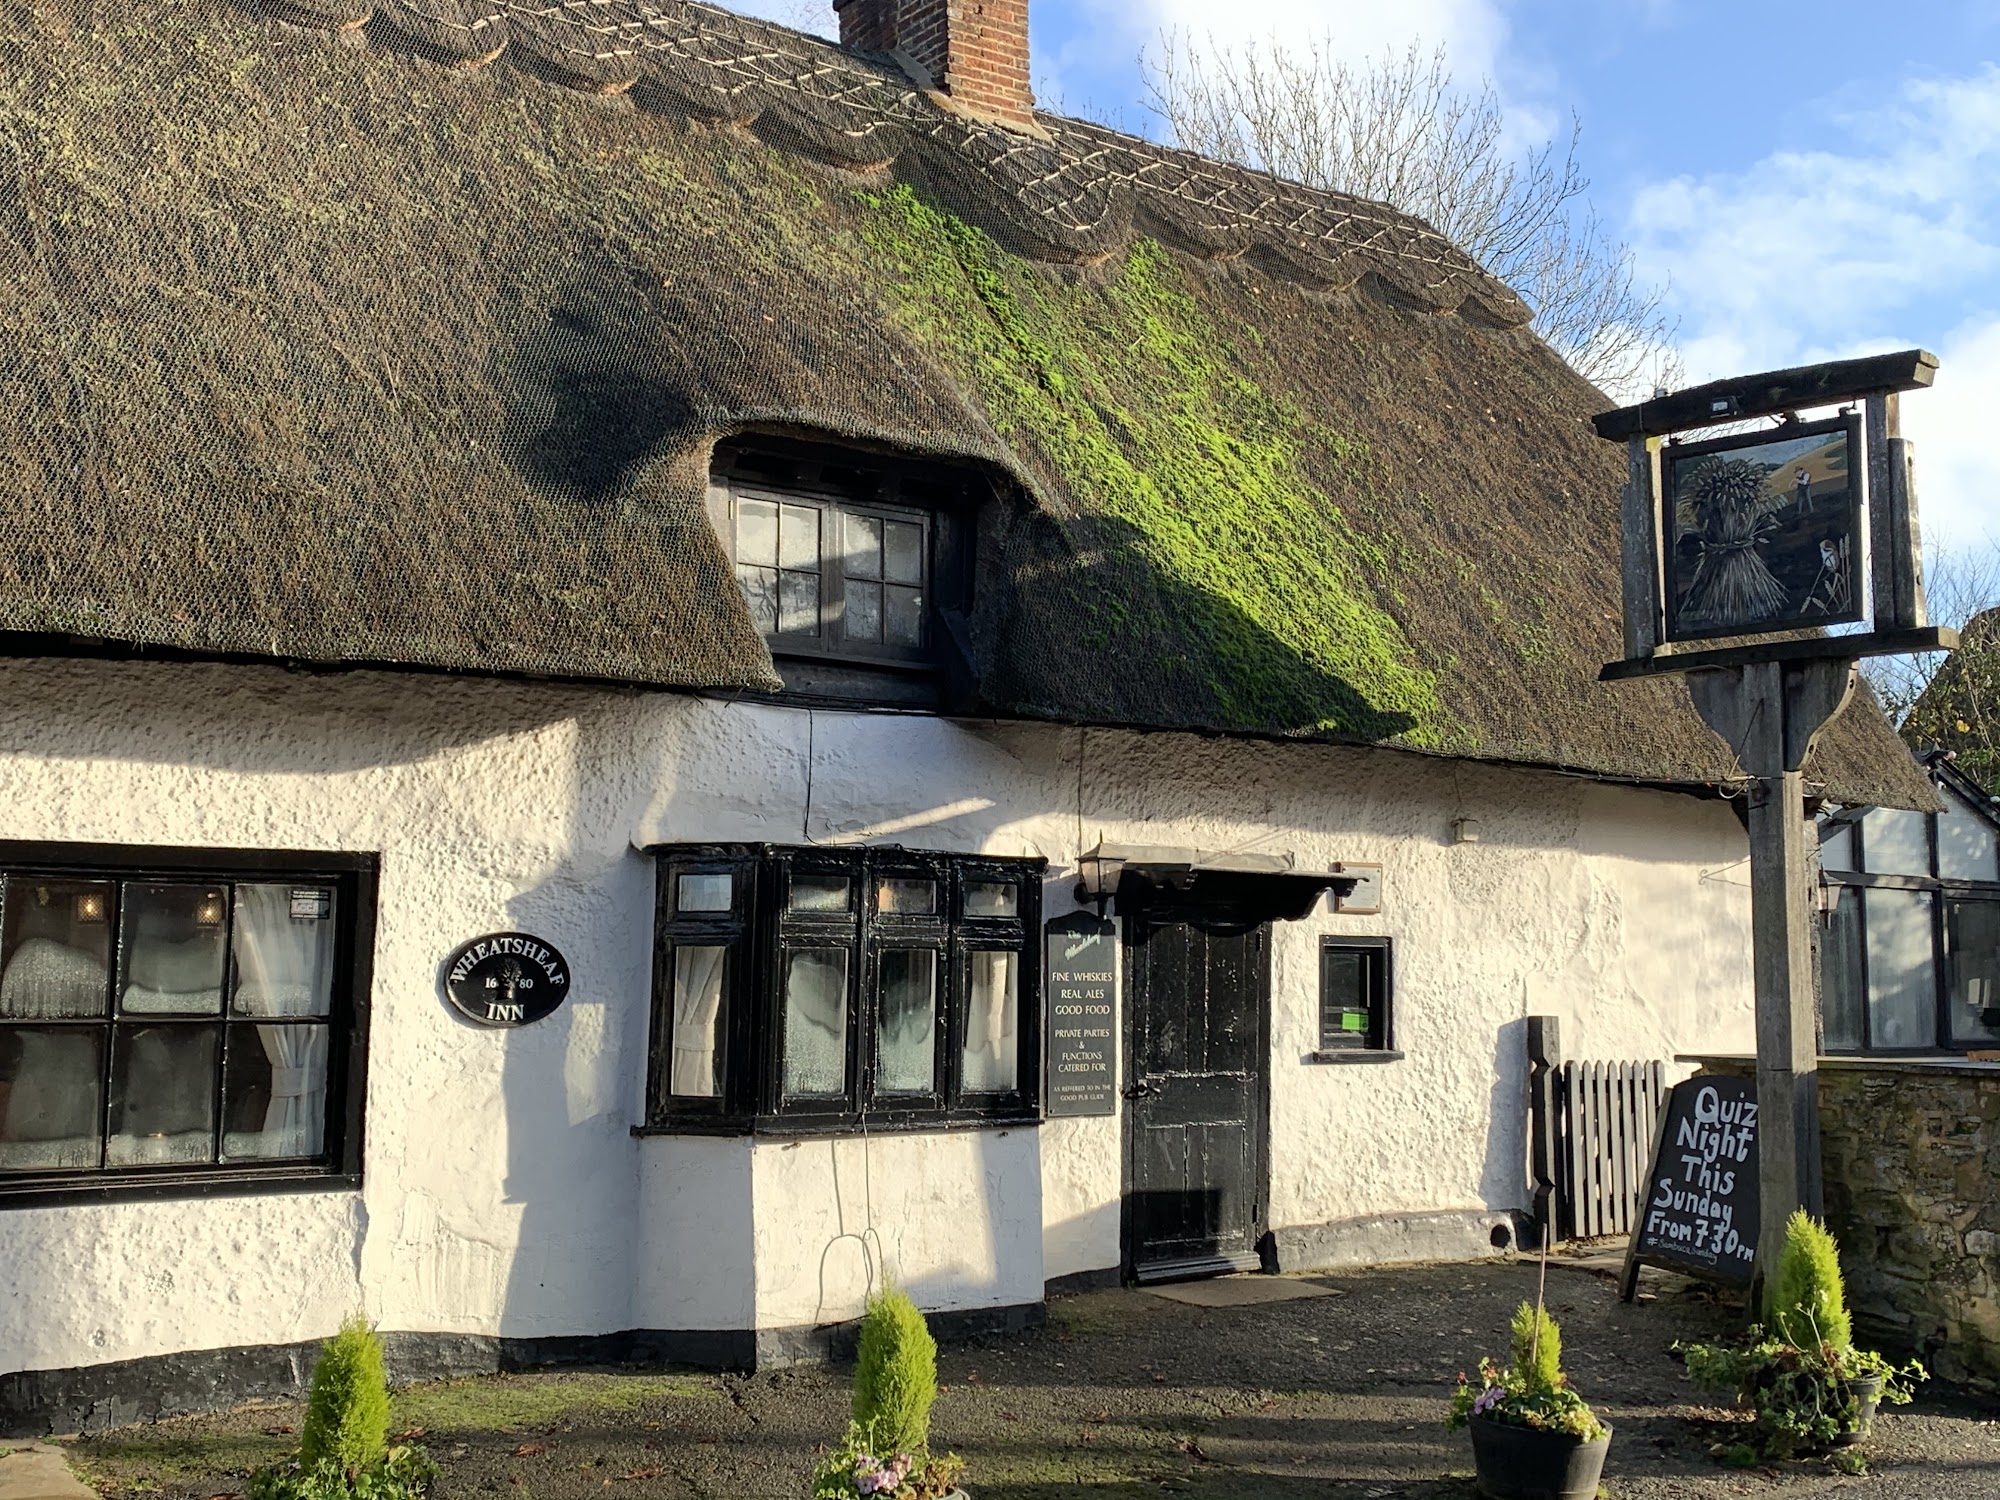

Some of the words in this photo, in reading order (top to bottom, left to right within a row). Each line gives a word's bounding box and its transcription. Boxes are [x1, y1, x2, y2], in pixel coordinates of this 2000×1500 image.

[450, 938, 565, 985] WHEATSHEAF
[485, 977, 498, 989] 16
[519, 979, 533, 989] 80
[1052, 972, 1070, 982] FINE
[1073, 972, 1113, 982] WHISKIES
[1061, 989, 1082, 999] REAL
[1085, 989, 1105, 999] ALES
[486, 1004, 525, 1021] INN
[1055, 1005, 1083, 1015] GOOD
[1085, 1005, 1110, 1015] FOOD
[1054, 1028, 1081, 1038] PRIVATE
[1083, 1028, 1110, 1038] PARTIES
[1079, 1040, 1085, 1049] &
[1062, 1051, 1103, 1061] FUNCTIONS
[1058, 1063, 1090, 1073] CATERED
[1091, 1062, 1106, 1072] FOR
[1695, 1086, 1759, 1129] Quiz
[1676, 1116, 1753, 1163] Night
[1681, 1154, 1736, 1195] This
[1653, 1178, 1733, 1233] Sunday
[1647, 1210, 1692, 1241] From
